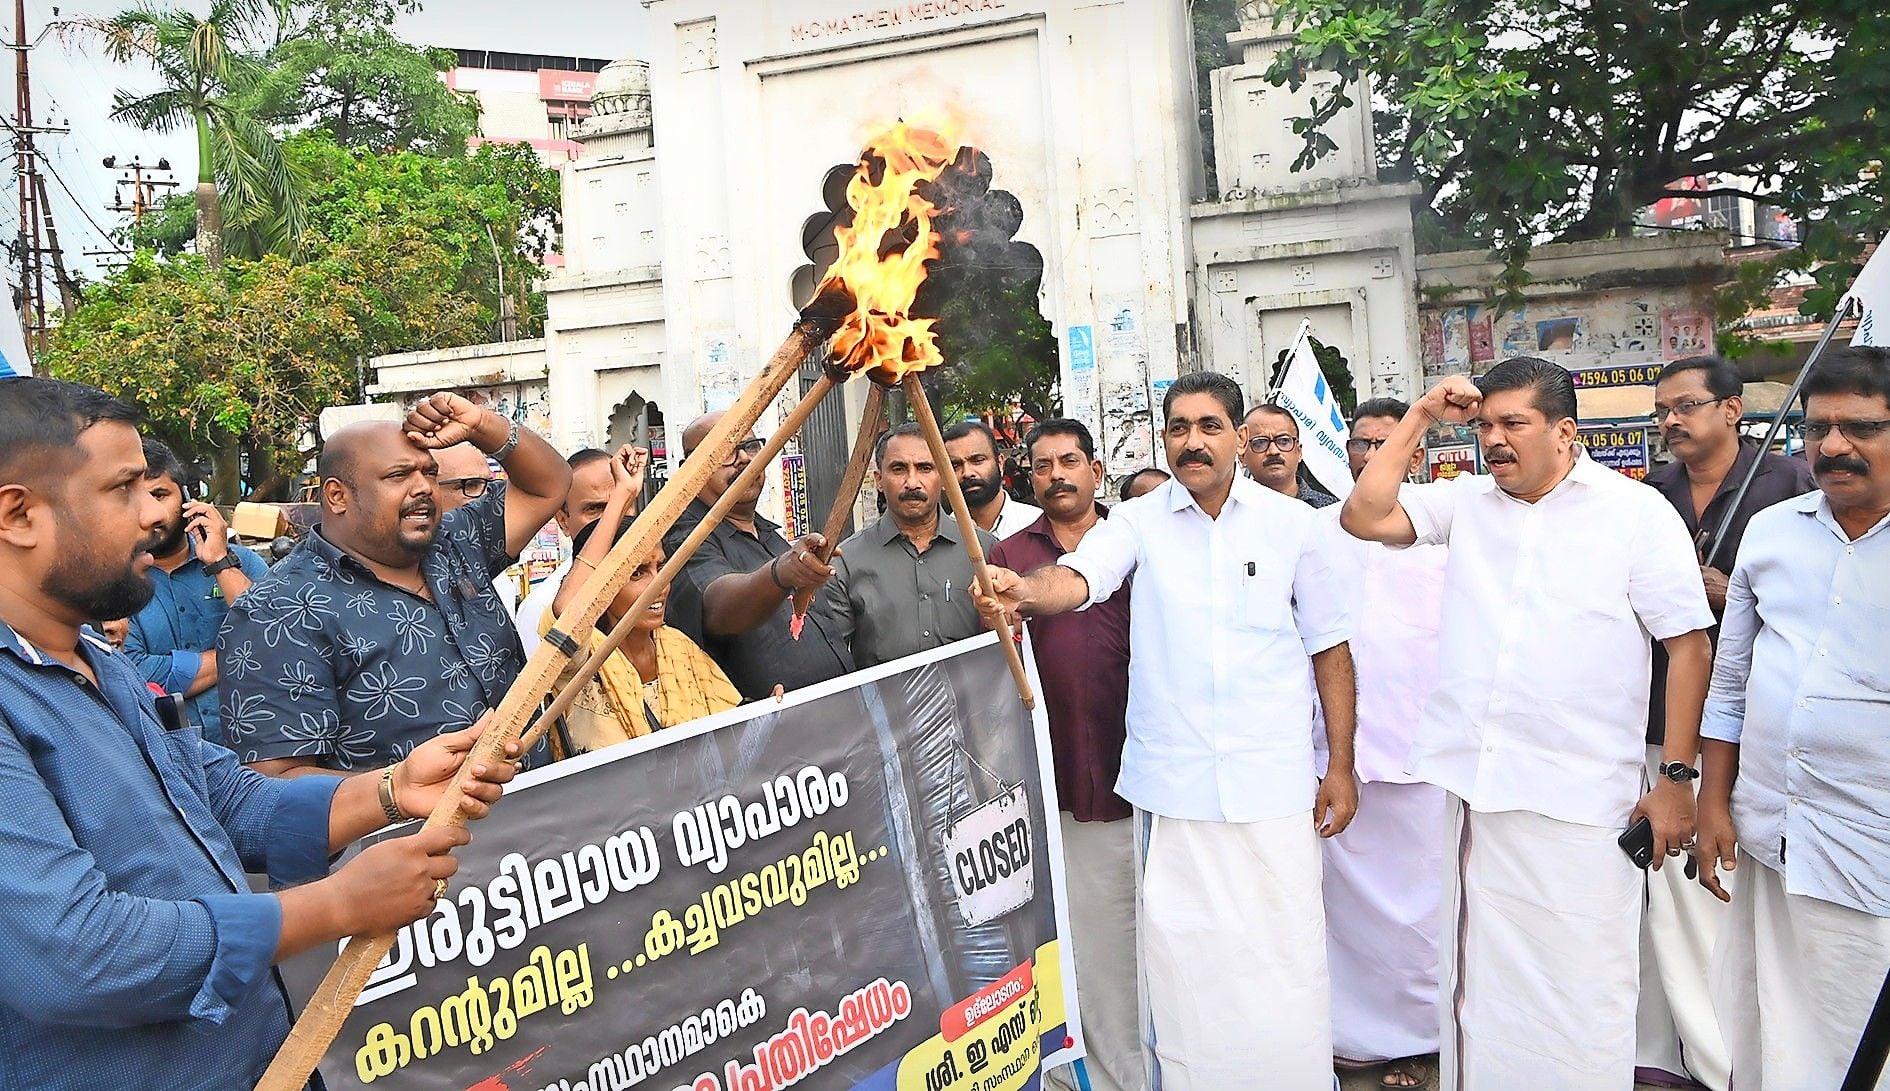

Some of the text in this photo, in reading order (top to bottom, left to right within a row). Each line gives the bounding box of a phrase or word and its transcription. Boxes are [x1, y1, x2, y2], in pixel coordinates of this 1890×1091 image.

[909, 0, 1005, 21] MEMORIAL
[1580, 367, 1660, 386] 7594 05 06 07
[1437, 450, 1467, 463] CITU
[1576, 431, 1642, 447] 94 05 06 07
[671, 765, 849, 874] വ്യാപാരം
[955, 817, 1031, 897] CLOSED
[354, 942, 595, 1084] കറന്റുമില്ല
[966, 1038, 989, 1074] ഇ
[991, 1000, 1026, 1054] എസ്
